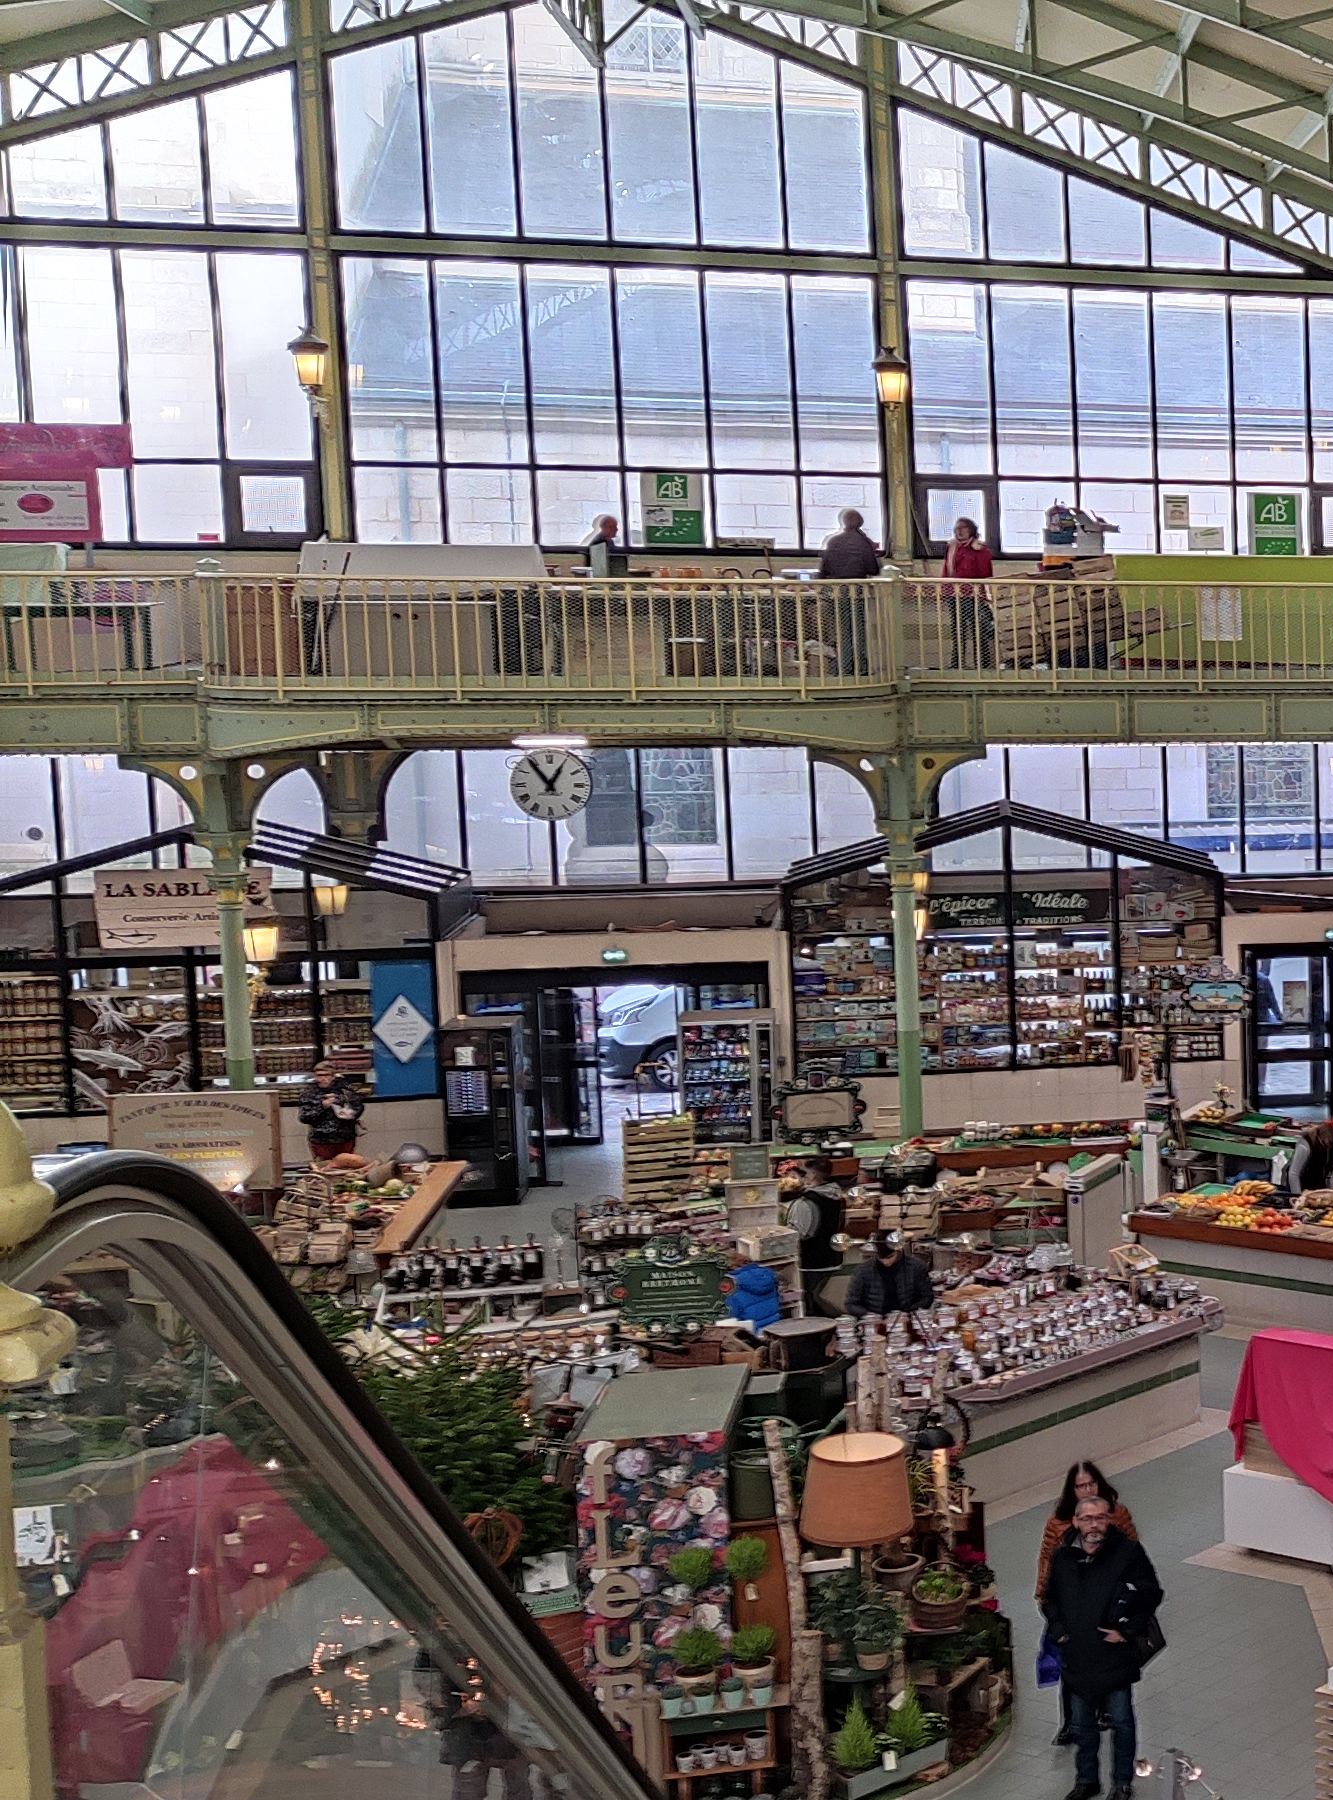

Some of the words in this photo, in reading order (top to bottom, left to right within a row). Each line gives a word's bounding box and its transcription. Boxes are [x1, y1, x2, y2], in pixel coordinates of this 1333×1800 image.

[658, 481, 684, 499] AB
[1260, 503, 1288, 522] AB
[104, 882, 138, 898] LA
[142, 881, 262, 898] SABLAE
[1031, 892, 1091, 910] Idéale
[123, 912, 190, 924] Conserverie
